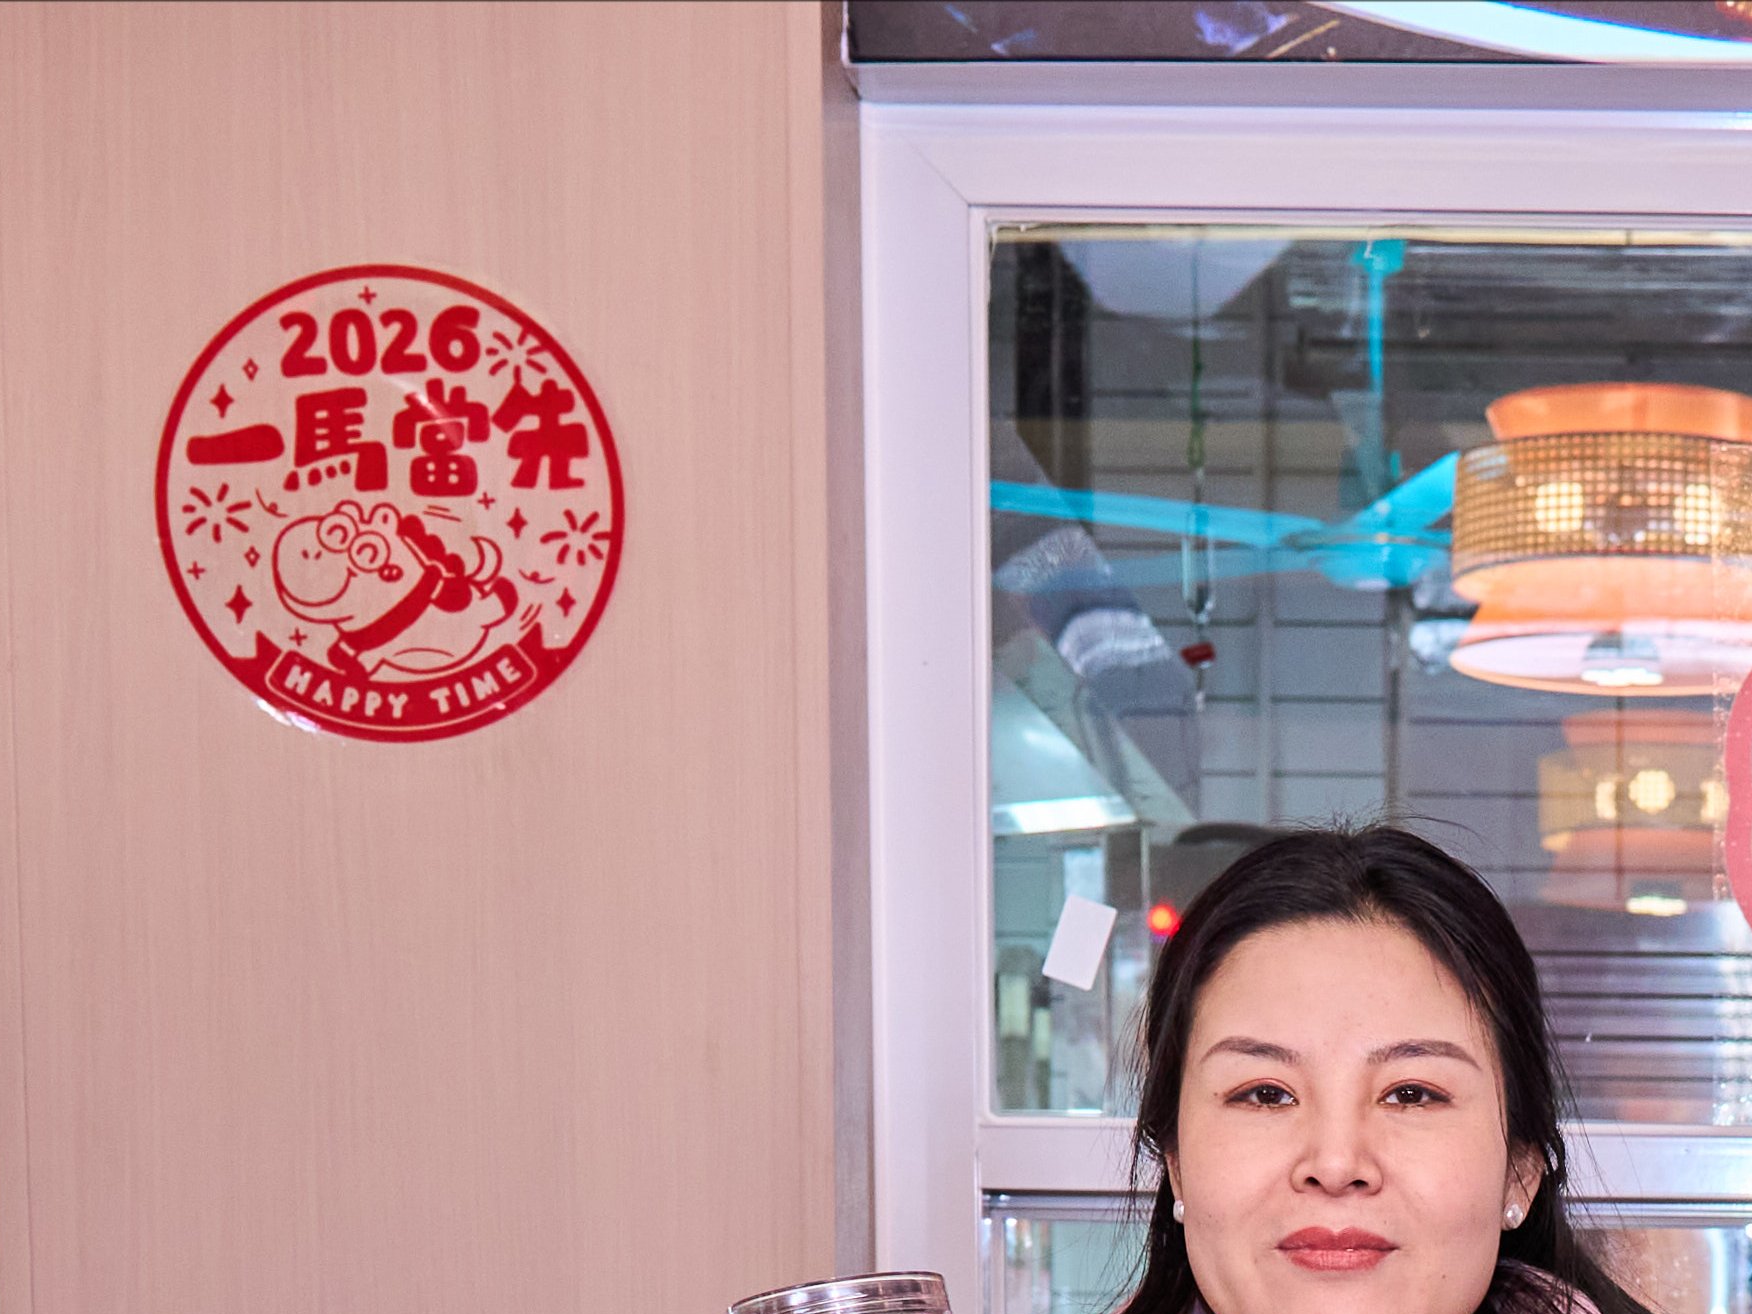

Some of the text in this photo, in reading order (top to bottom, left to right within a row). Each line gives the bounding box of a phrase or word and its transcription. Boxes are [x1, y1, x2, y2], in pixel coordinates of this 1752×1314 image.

[279, 305, 481, 379] 2026
[185, 377, 590, 498] 一馬當先
[283, 657, 522, 719] HAPPY TIME
